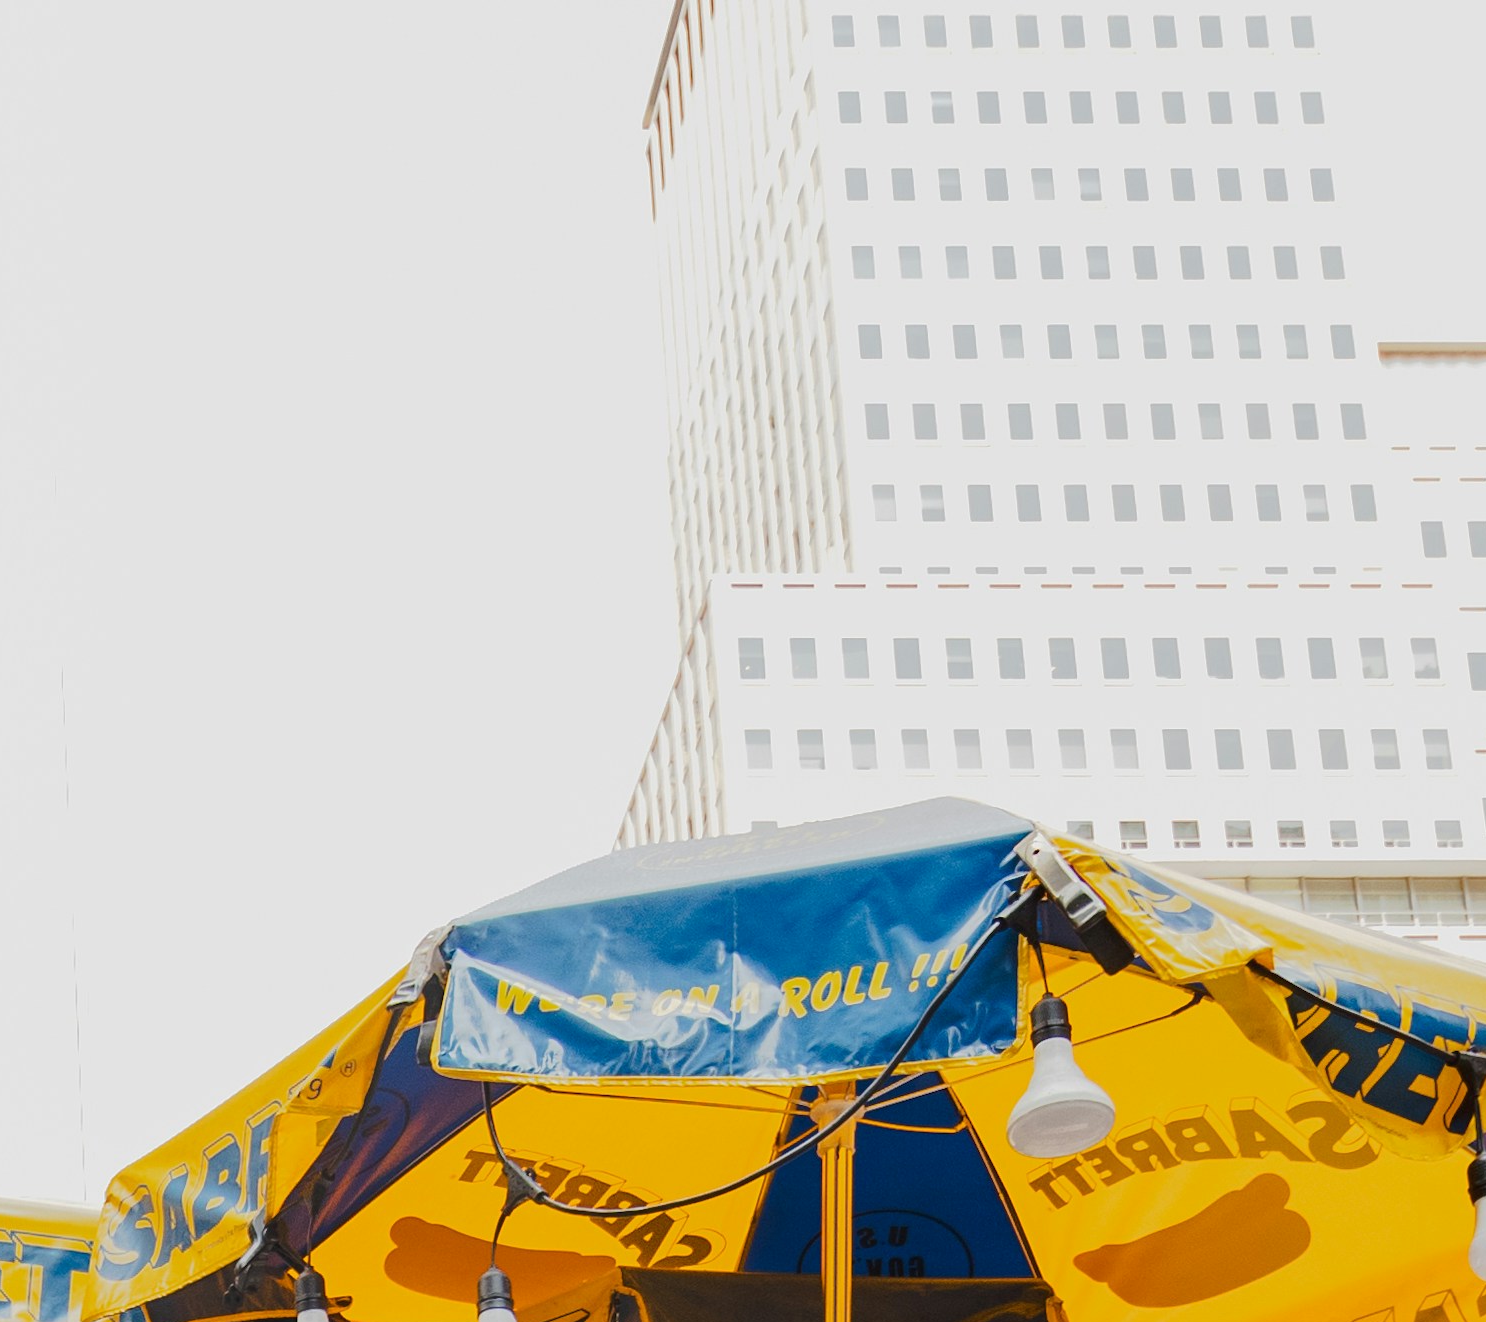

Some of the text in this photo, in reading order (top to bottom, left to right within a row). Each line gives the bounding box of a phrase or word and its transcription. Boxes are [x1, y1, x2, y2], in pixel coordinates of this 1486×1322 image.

[653, 979, 721, 1018] ON
[731, 981, 764, 1015] A
[779, 960, 893, 1019] ROLL
[908, 944, 967, 993] !!!
